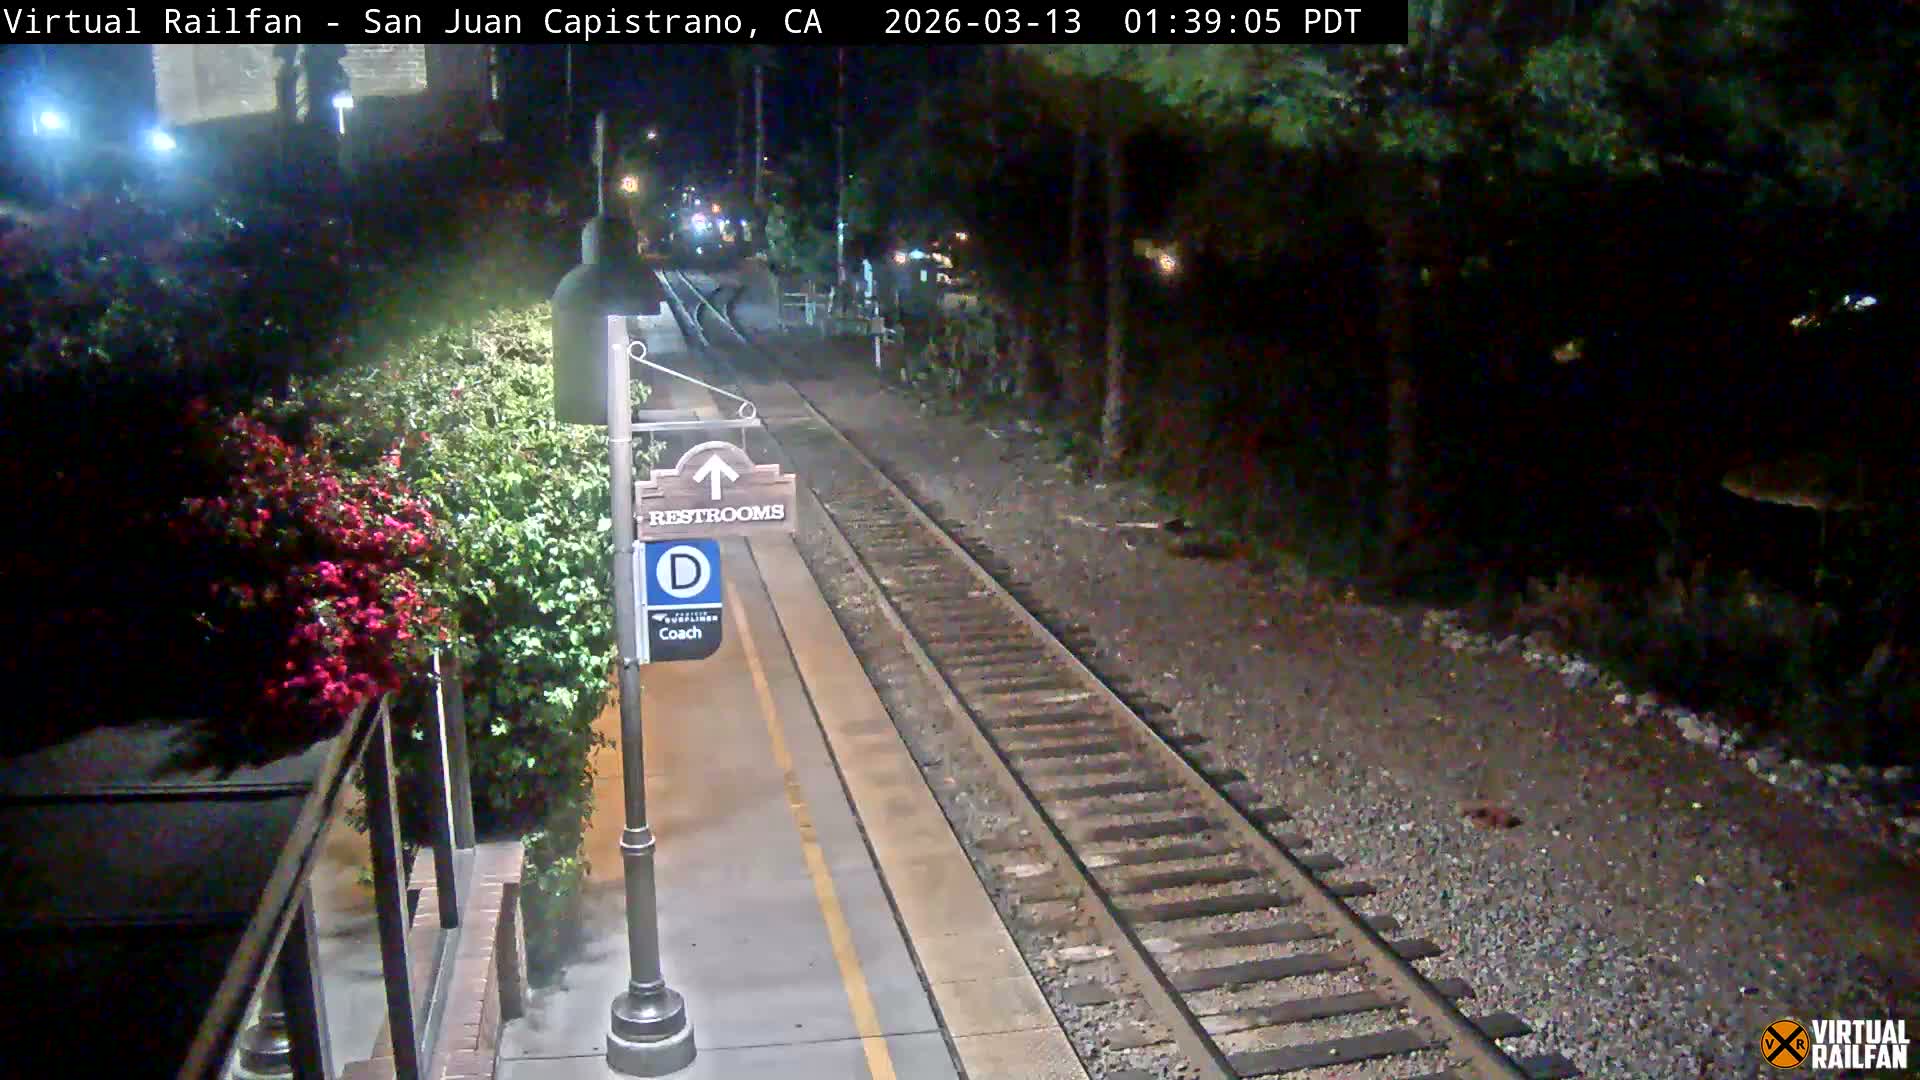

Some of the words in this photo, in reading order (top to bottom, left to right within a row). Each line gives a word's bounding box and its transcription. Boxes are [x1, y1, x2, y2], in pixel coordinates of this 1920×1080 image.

[649, 504, 785, 526] RESTROOMS
[670, 553, 701, 590] D
[659, 625, 703, 640] Coach
